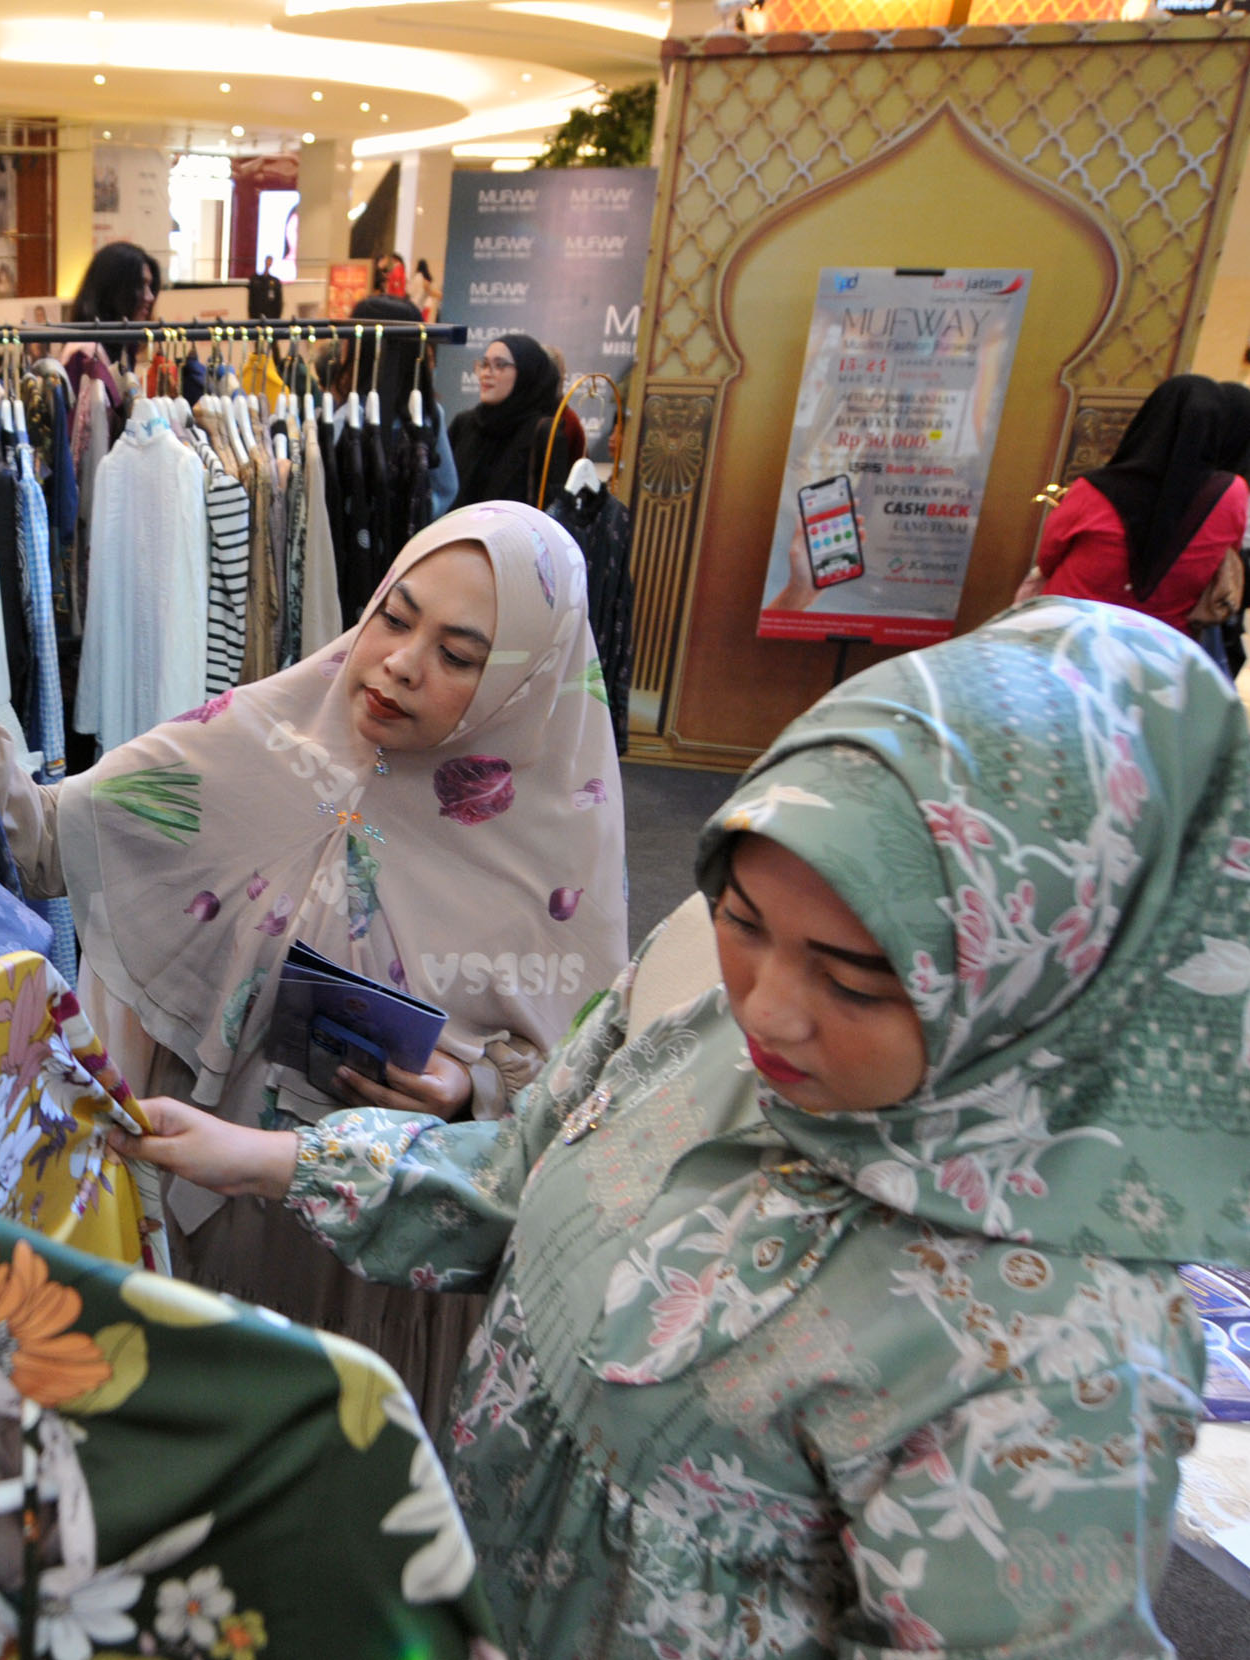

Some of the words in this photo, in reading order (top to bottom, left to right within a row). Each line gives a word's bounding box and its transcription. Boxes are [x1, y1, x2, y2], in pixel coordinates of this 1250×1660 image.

[842, 307, 991, 337] MUFWAY
[884, 501, 971, 518] CASHBACK
[420, 952, 585, 997] SISESA
